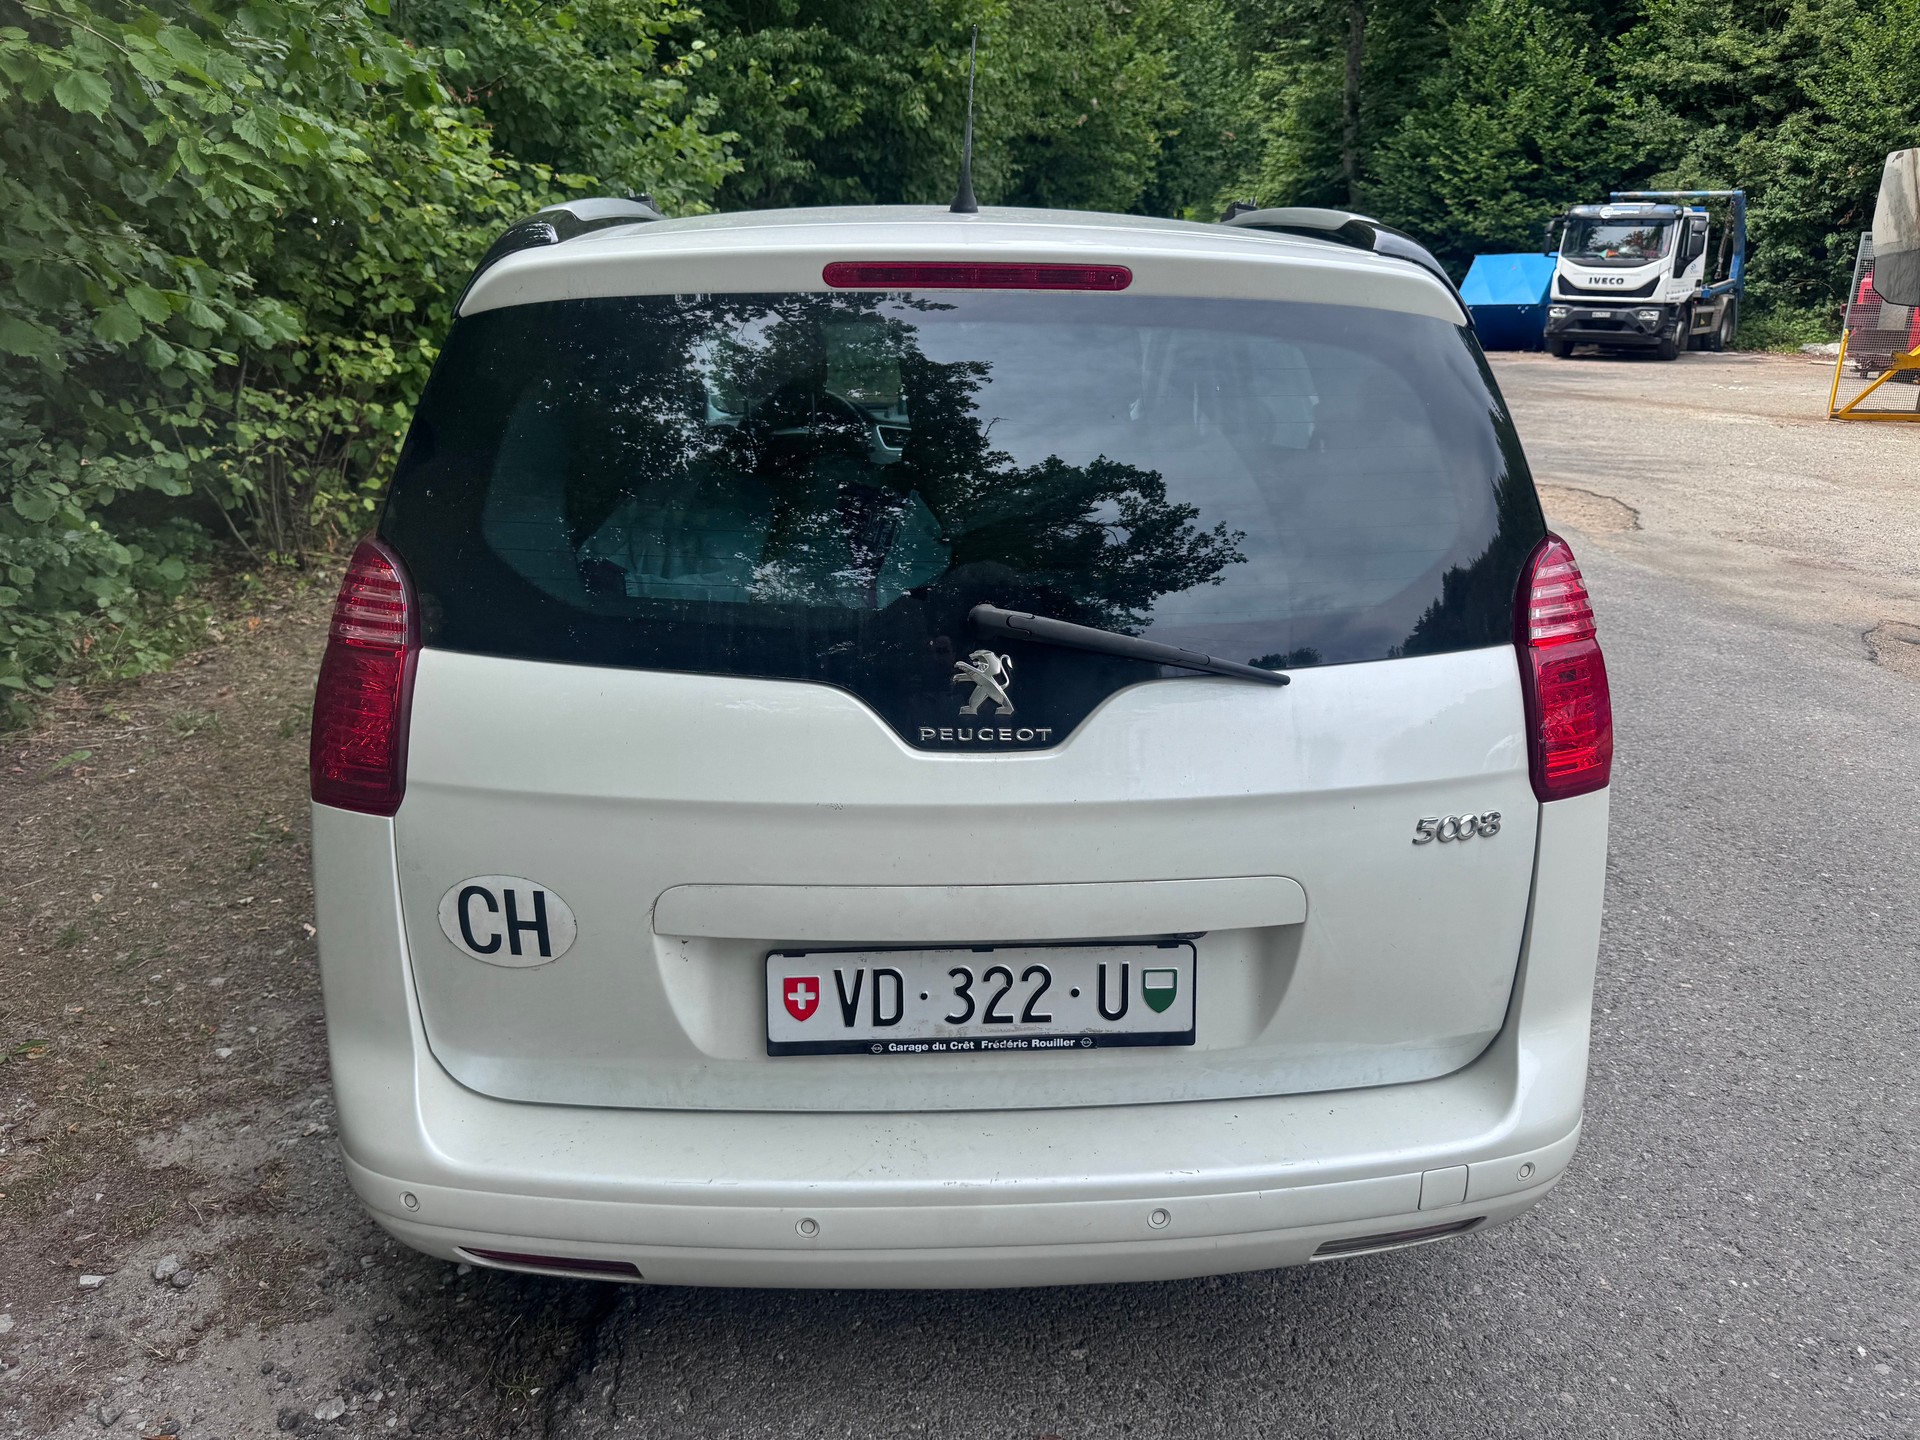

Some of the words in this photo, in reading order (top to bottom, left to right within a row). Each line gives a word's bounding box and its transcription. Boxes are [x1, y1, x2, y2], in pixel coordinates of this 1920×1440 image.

[1588, 276, 1625, 285] IVECO
[918, 726, 1053, 742] PEUGEOT
[1411, 809, 1502, 845] 5008
[457, 885, 552, 957] CH
[833, 965, 905, 1028] VD
[944, 963, 1054, 1025] 322
[1096, 961, 1130, 1021] U
[888, 1043, 929, 1052] Garage
[932, 1042, 946, 1050] du
[950, 1040, 975, 1050] Crêt
[981, 1039, 1028, 1049] Frédéric
[1031, 1038, 1076, 1048] Rouiller
